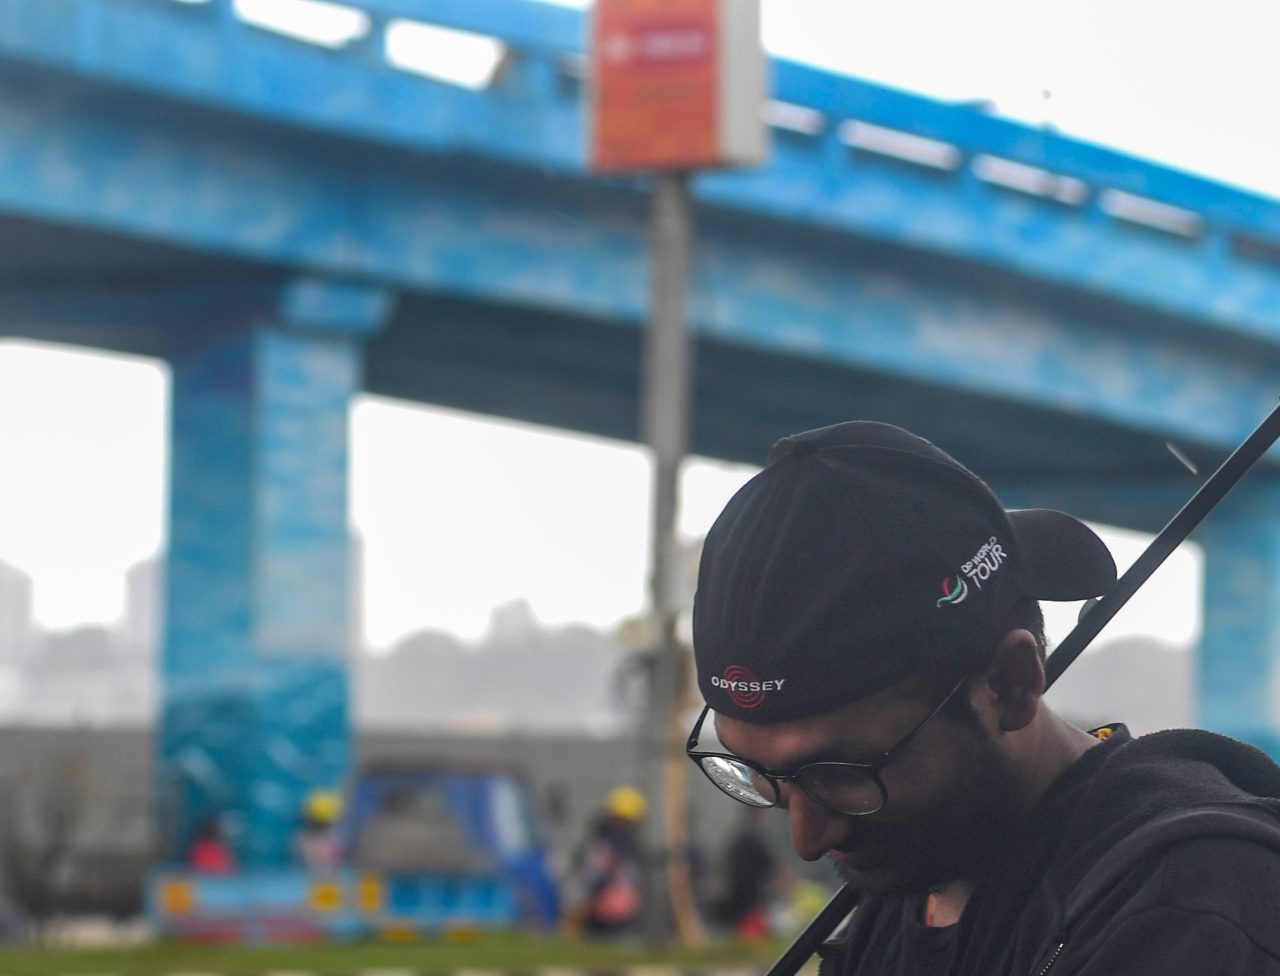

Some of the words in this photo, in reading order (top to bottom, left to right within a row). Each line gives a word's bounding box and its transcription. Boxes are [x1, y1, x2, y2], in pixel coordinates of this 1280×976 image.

[961, 561, 973, 573] DP
[971, 536, 997, 565] WORLD
[966, 544, 1007, 591] TOUR
[711, 676, 786, 691] ODYSSEY
